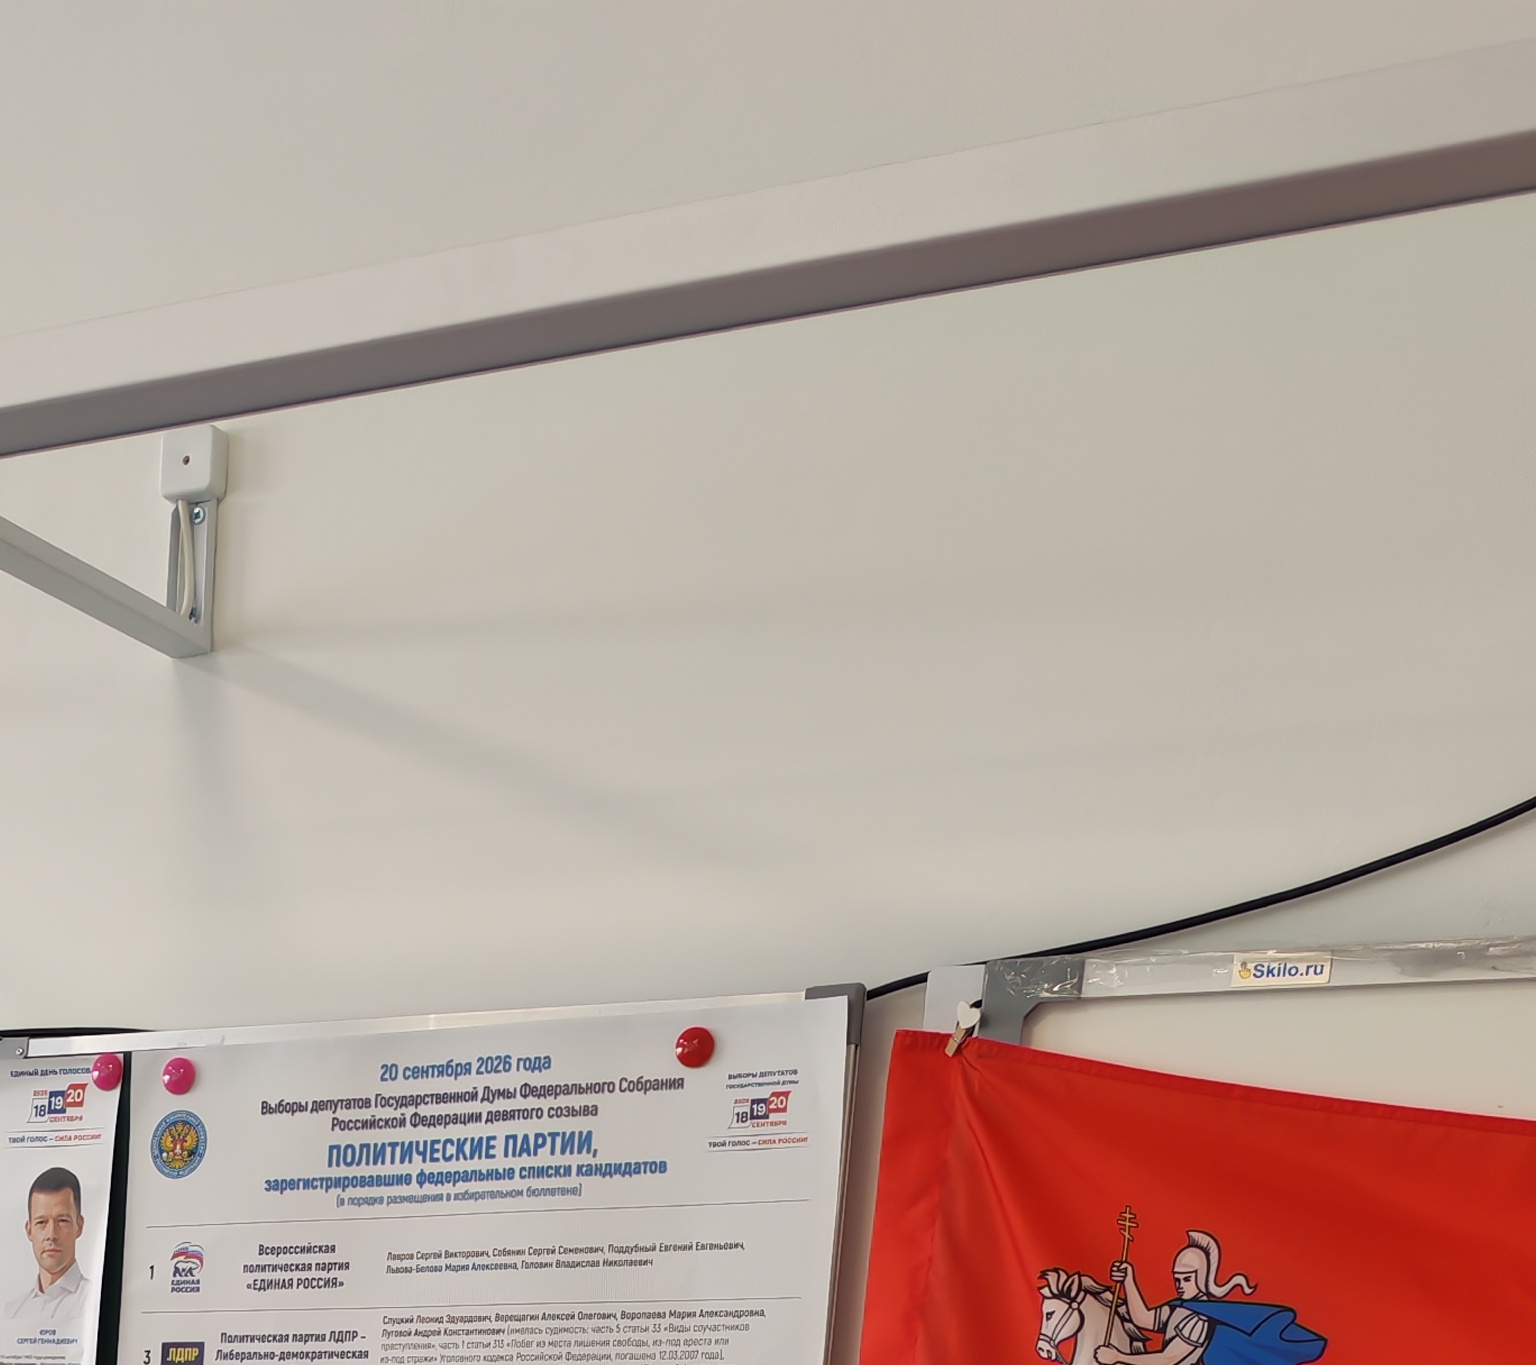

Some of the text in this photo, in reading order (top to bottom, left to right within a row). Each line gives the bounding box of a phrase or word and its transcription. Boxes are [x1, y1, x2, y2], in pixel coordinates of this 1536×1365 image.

[1252, 962, 1325, 980] Skilo.ru
[379, 1054, 551, 1082] 20 сентября 2026 года
[34, 1089, 84, 1118] 18 19 20
[260, 1077, 684, 1115] Выборы депутатов Государственной Думы Федерального Собрания
[330, 1104, 598, 1131] Российской Федерации девятого созыва
[734, 1096, 786, 1124] 18 19 20
[327, 1130, 598, 1167] ПОЛИТИЧЕСКИЕ ПАРТИИ,
[263, 1160, 667, 1192] зарегистрировавшие федеральные списки кандидатов
[257, 1242, 336, 1256] Всероссийская
[386, 1241, 745, 1262] Лавров Сергей Викторович, Собянин Сергей Семенович, Поддубный Евгений Евгеньевич,
[148, 1264, 154, 1280] 1
[242, 1261, 350, 1273] политическая партия
[246, 1277, 344, 1291] «ЕДИНАЯ РОССИЯ»
[220, 1330, 358, 1344] Политическая партия ЛДПР
[144, 1350, 151, 1365] 3
[166, 1346, 199, 1362] ЛДПР
[214, 1349, 368, 1362] Либерально-демократическая
